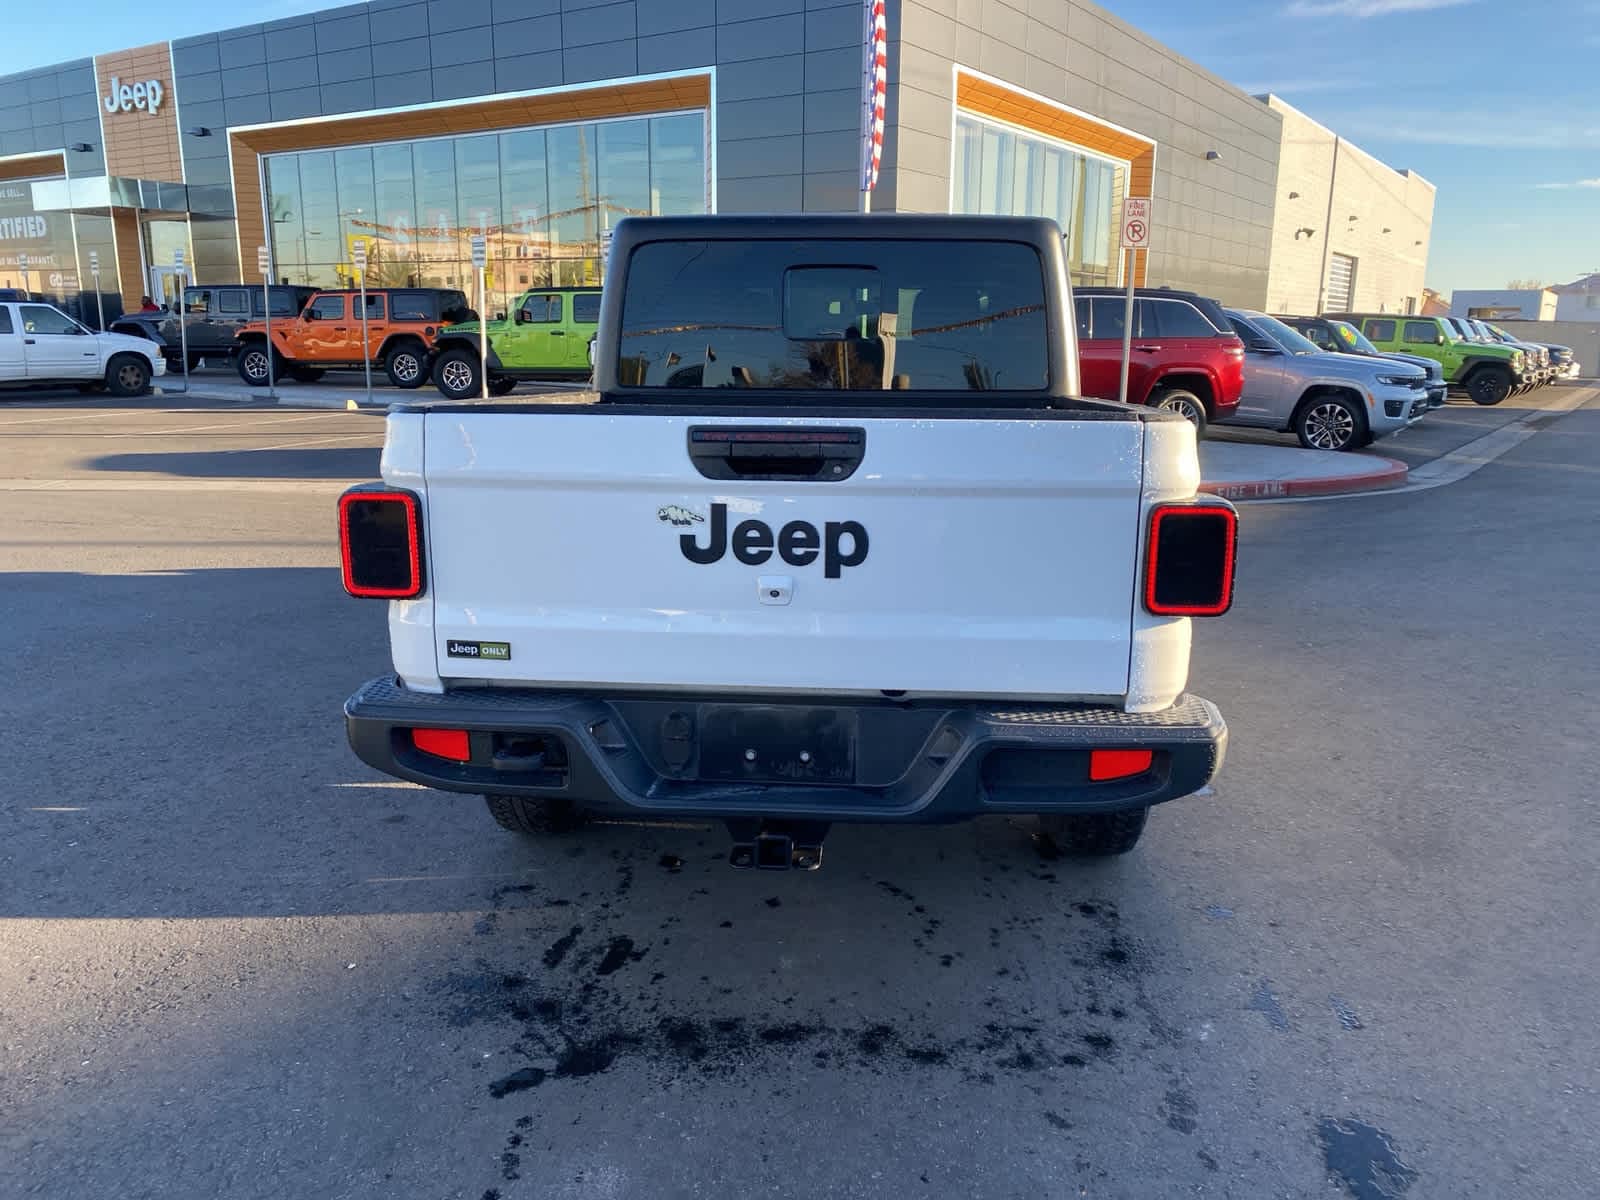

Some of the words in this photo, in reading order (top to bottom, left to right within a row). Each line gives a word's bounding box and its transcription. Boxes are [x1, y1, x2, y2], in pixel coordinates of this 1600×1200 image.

[104, 75, 163, 115] Jeep
[1129, 201, 1145, 209] FIRE
[1128, 209, 1145, 217] LANE
[1217, 486, 1247, 498] FIRE
[680, 503, 869, 579] Jeep
[450, 643, 478, 656] Jeep
[482, 646, 507, 656] ONLY
